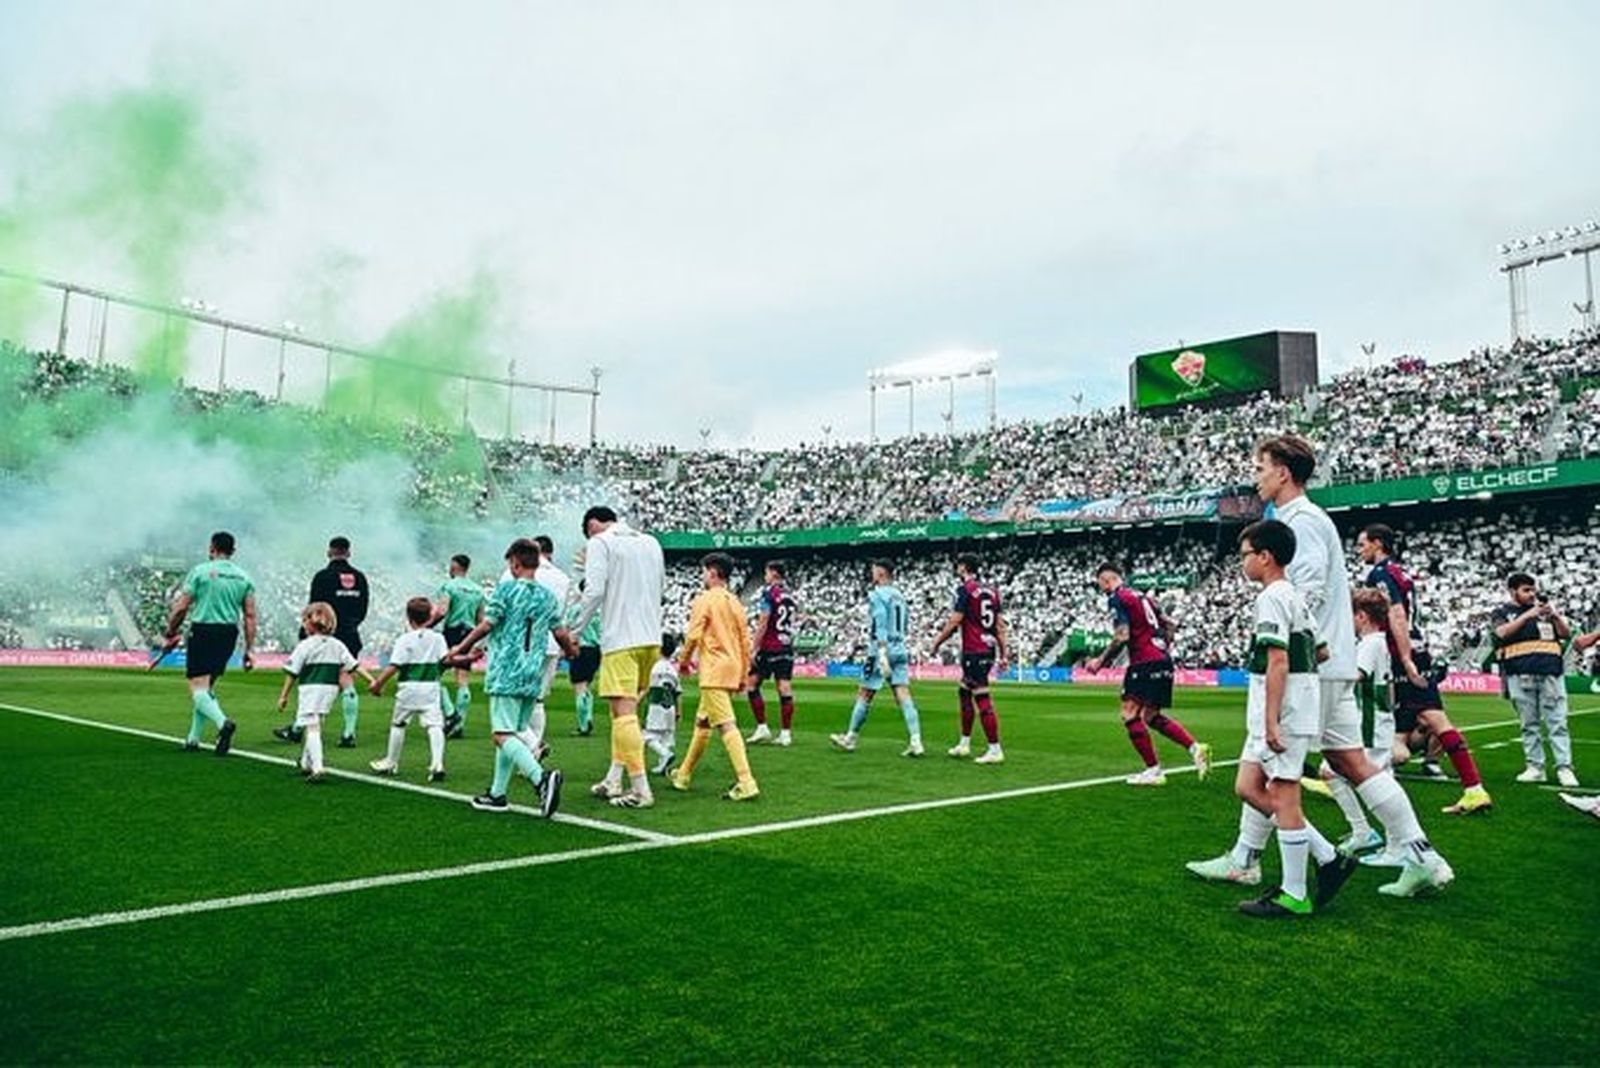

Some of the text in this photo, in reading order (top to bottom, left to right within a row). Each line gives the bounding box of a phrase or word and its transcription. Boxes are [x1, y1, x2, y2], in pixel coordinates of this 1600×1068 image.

[1455, 467, 1558, 491] ELCHECF
[980, 599, 995, 629] 5
[524, 616, 532, 652] 1
